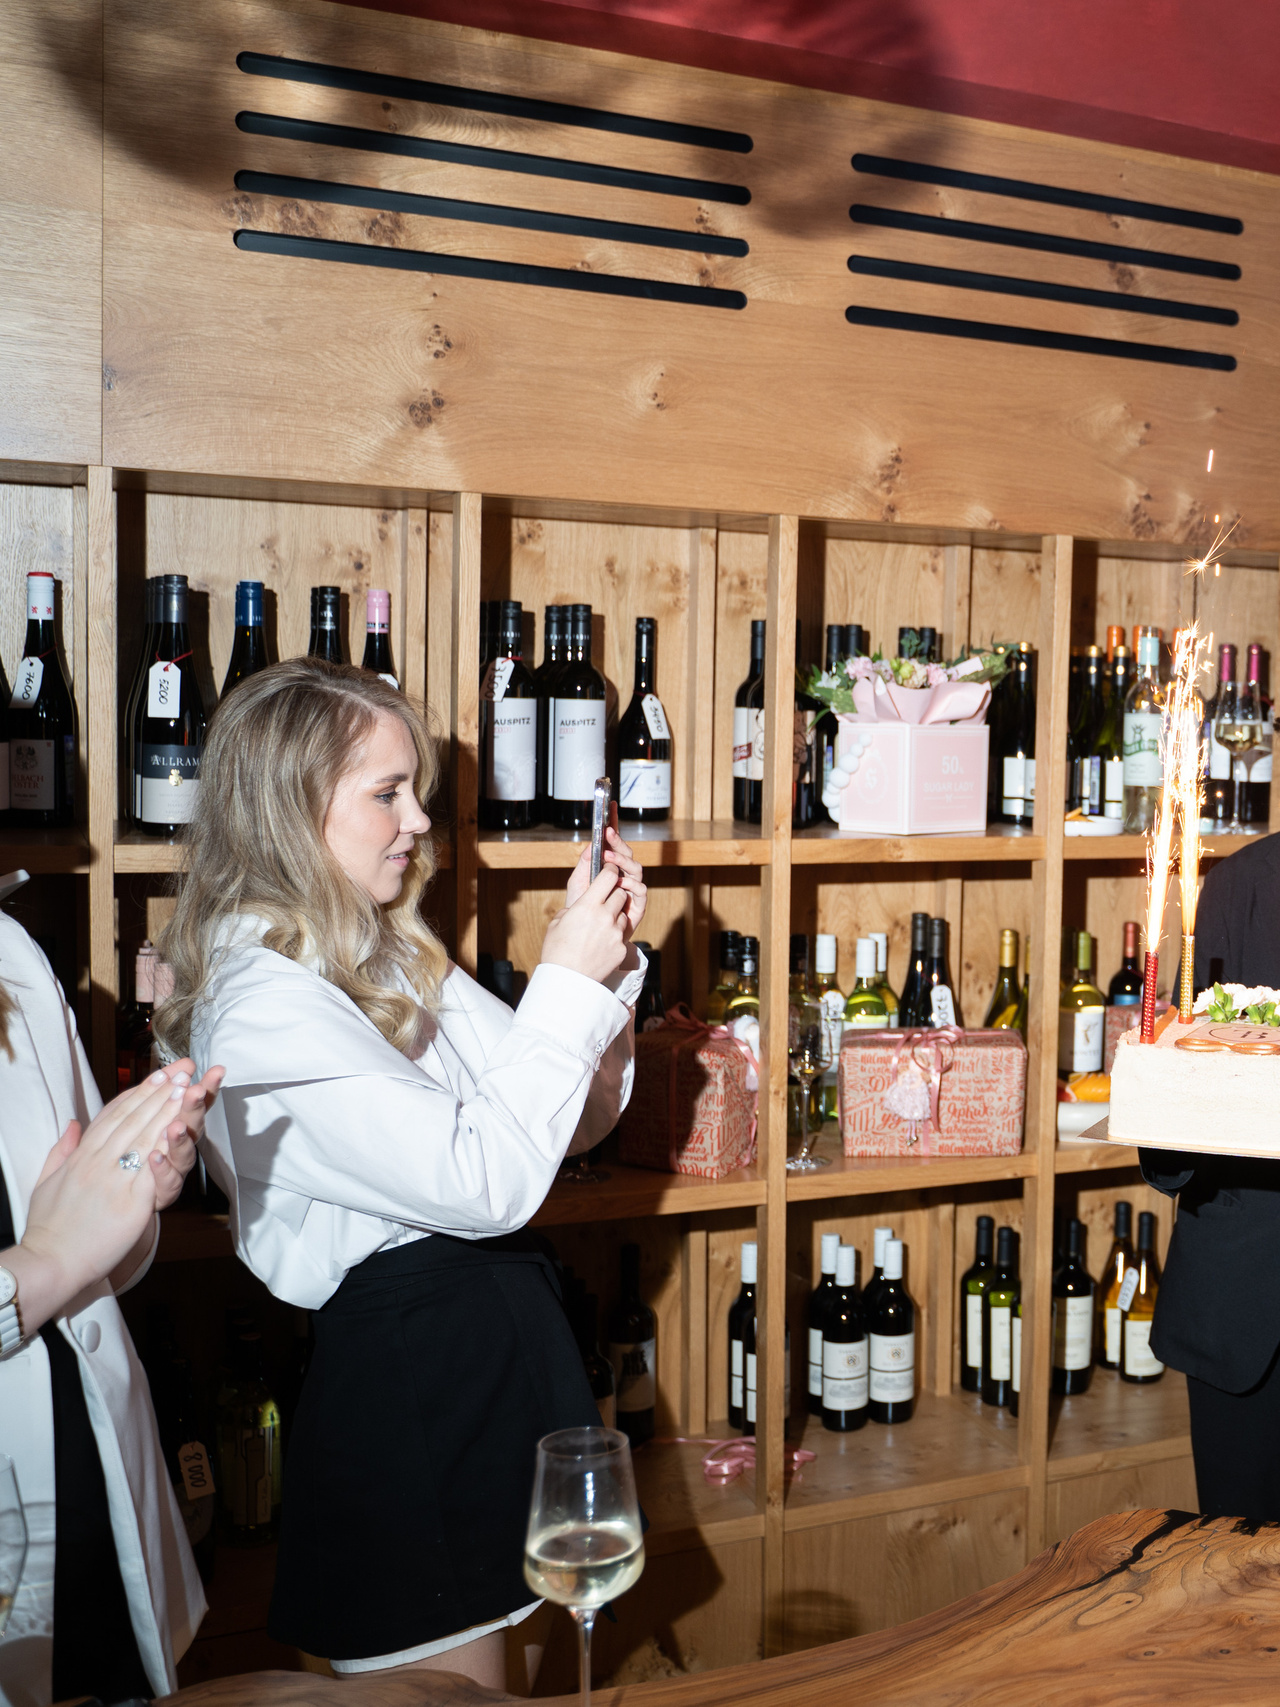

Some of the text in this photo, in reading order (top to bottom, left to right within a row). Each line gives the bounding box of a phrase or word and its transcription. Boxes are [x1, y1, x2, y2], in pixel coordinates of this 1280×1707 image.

[22, 672, 35, 700] 7600
[158, 678, 170, 705] 5200
[494, 717, 531, 726] AUSPITZ
[560, 718, 597, 727] AUSPITZ
[923, 781, 975, 793] SUGAR LADY
